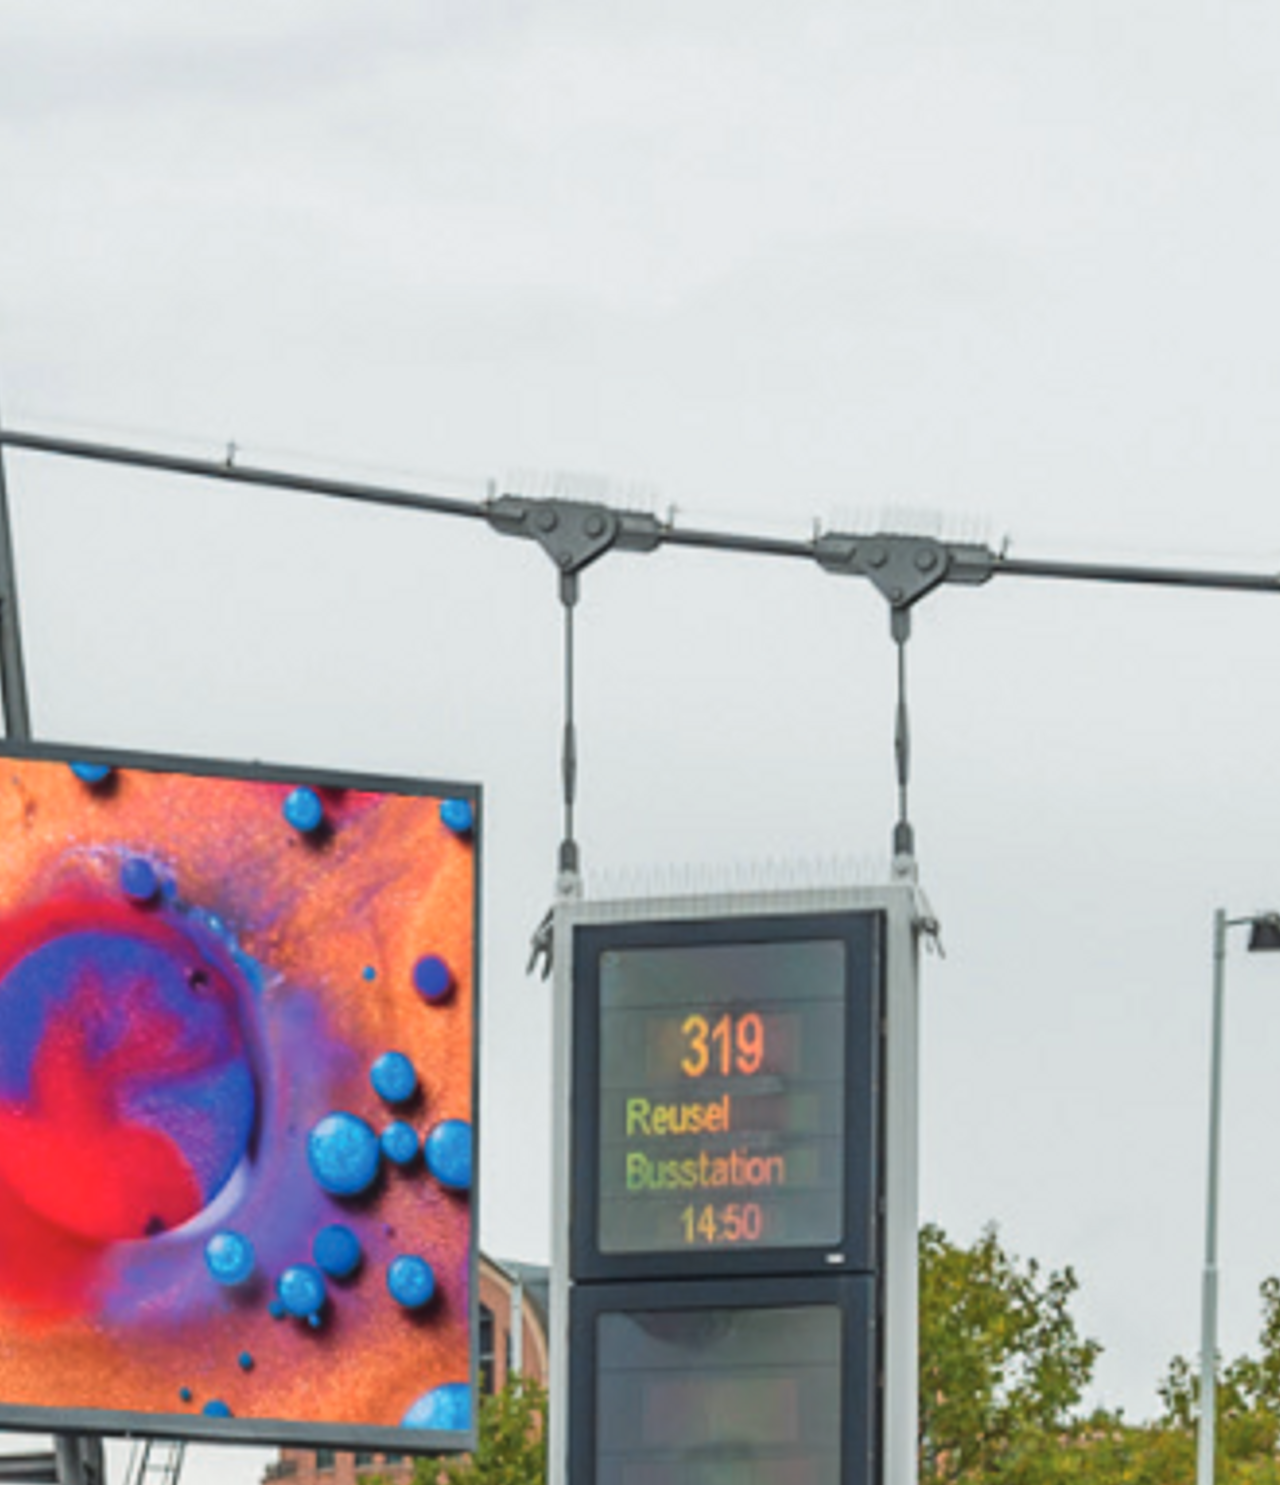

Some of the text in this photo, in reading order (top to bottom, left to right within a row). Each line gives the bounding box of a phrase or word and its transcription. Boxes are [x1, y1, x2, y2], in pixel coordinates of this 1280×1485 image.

[680, 1013, 764, 1077] 319
[626, 1094, 730, 1136] Reusel
[626, 1147, 785, 1190] Busstation
[681, 1203, 762, 1243] 14:50
